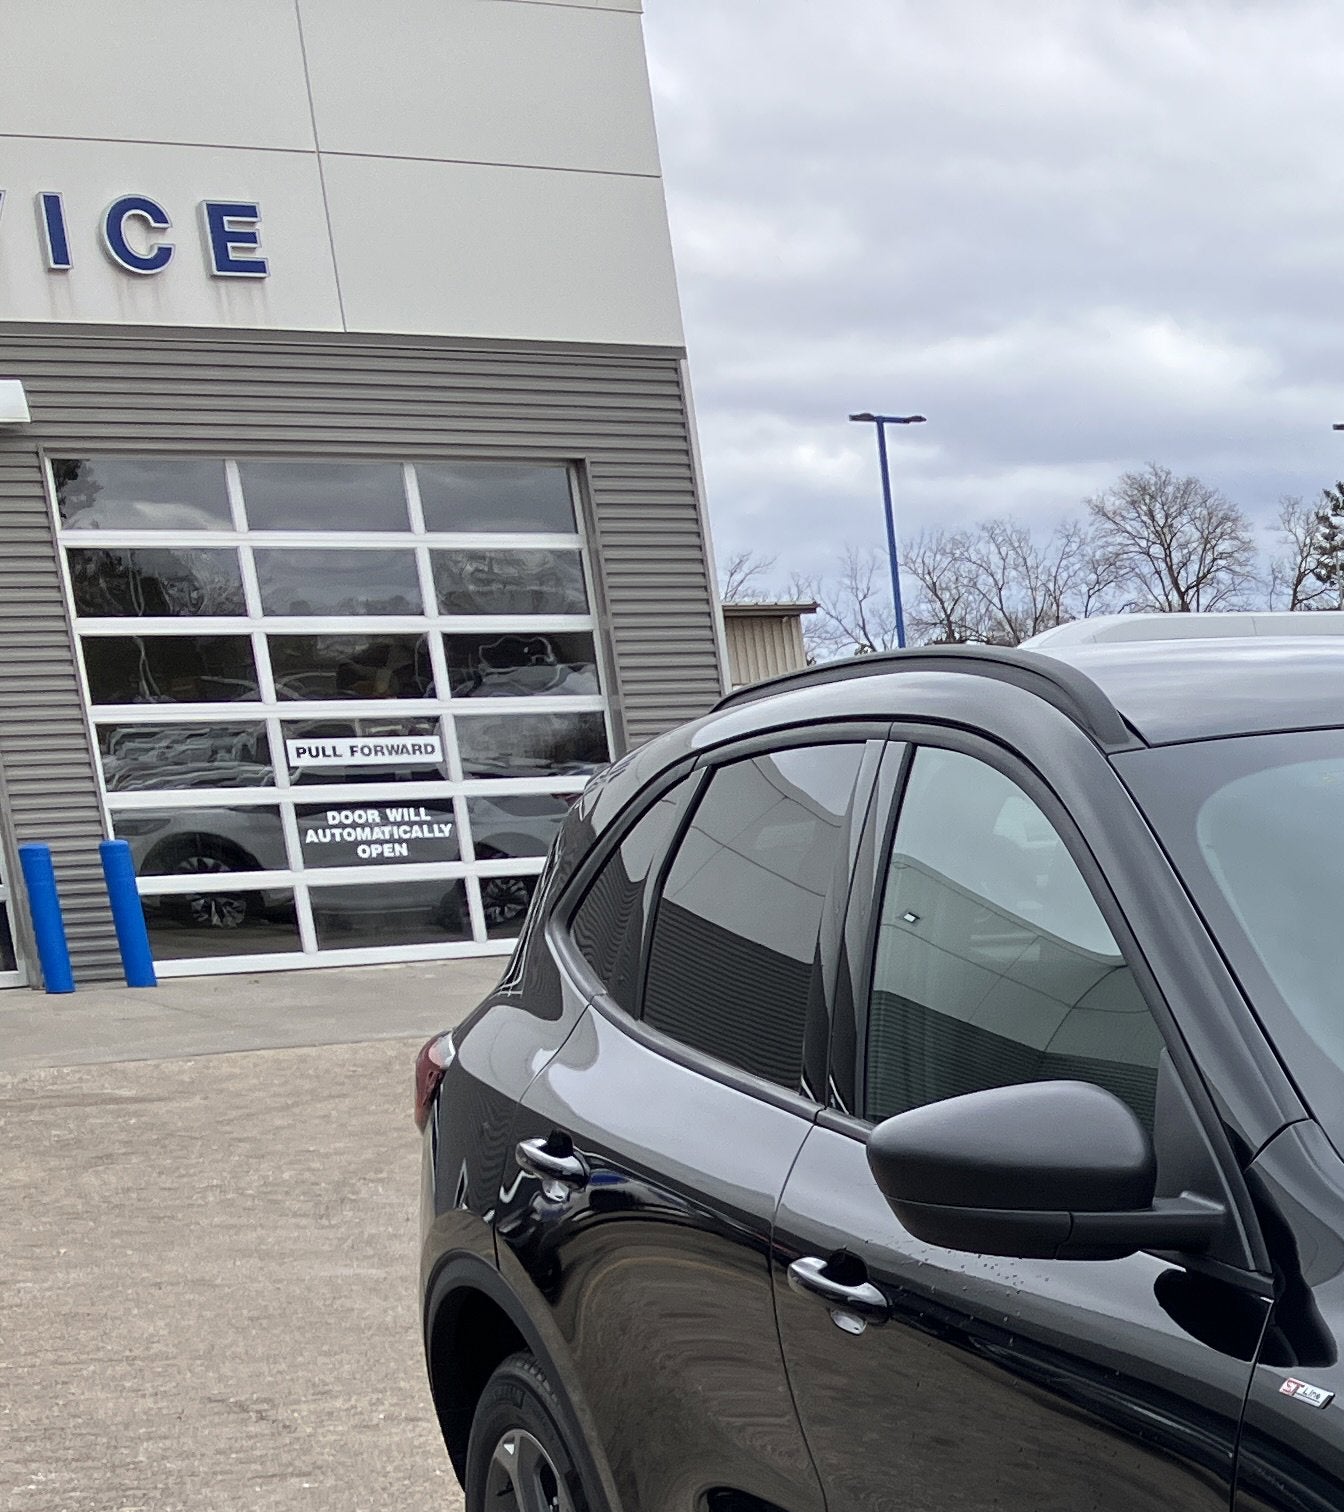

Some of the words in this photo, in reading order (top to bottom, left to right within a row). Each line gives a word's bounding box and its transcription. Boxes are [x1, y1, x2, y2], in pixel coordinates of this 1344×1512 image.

[0, 189, 271, 279] ICE
[295, 744, 343, 759] PULL
[349, 742, 436, 758] FORWARD
[326, 808, 382, 826] DOOR
[385, 806, 432, 822] WILL
[305, 822, 453, 844] AUTOMATICALLY
[356, 842, 409, 859] OPEN
